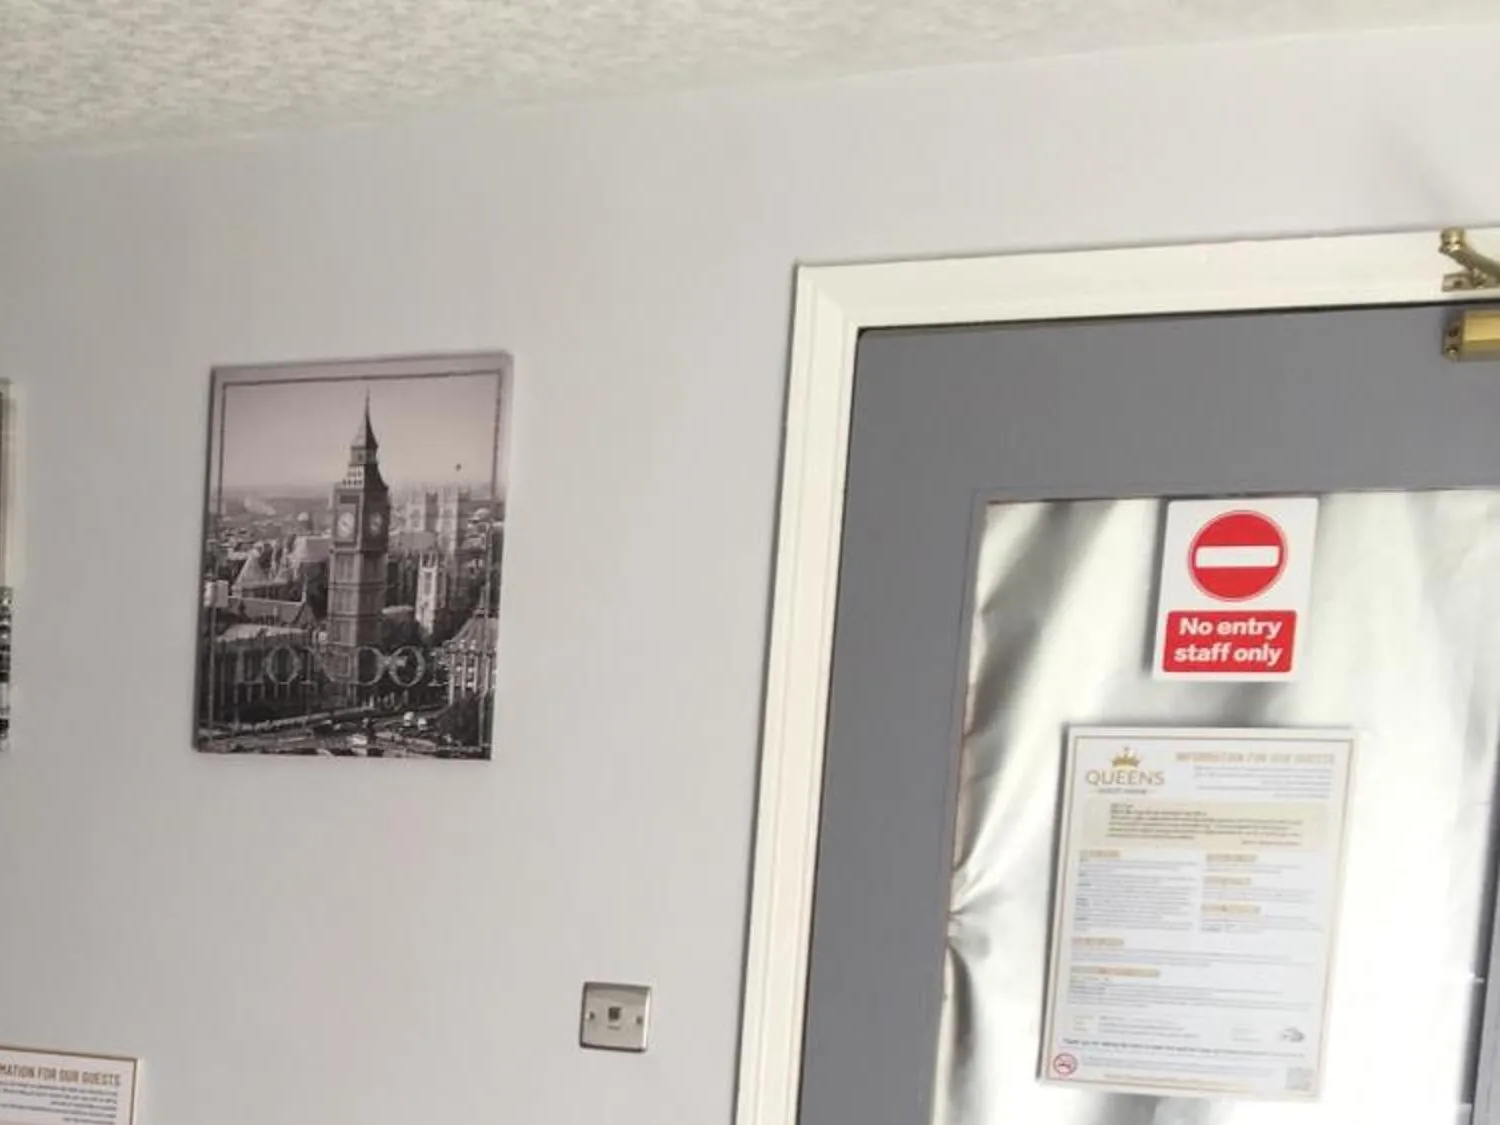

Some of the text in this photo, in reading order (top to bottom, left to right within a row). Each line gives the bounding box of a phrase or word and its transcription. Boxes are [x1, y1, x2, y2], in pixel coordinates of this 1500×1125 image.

[1179, 617, 1283, 639] No entry
[1174, 642, 1283, 667] staff only
[1084, 769, 1165, 786] QUEENS
[37, 1066, 57, 1081] FOR
[58, 1069, 80, 1083] OUR
[82, 1071, 122, 1086] GUESTS
